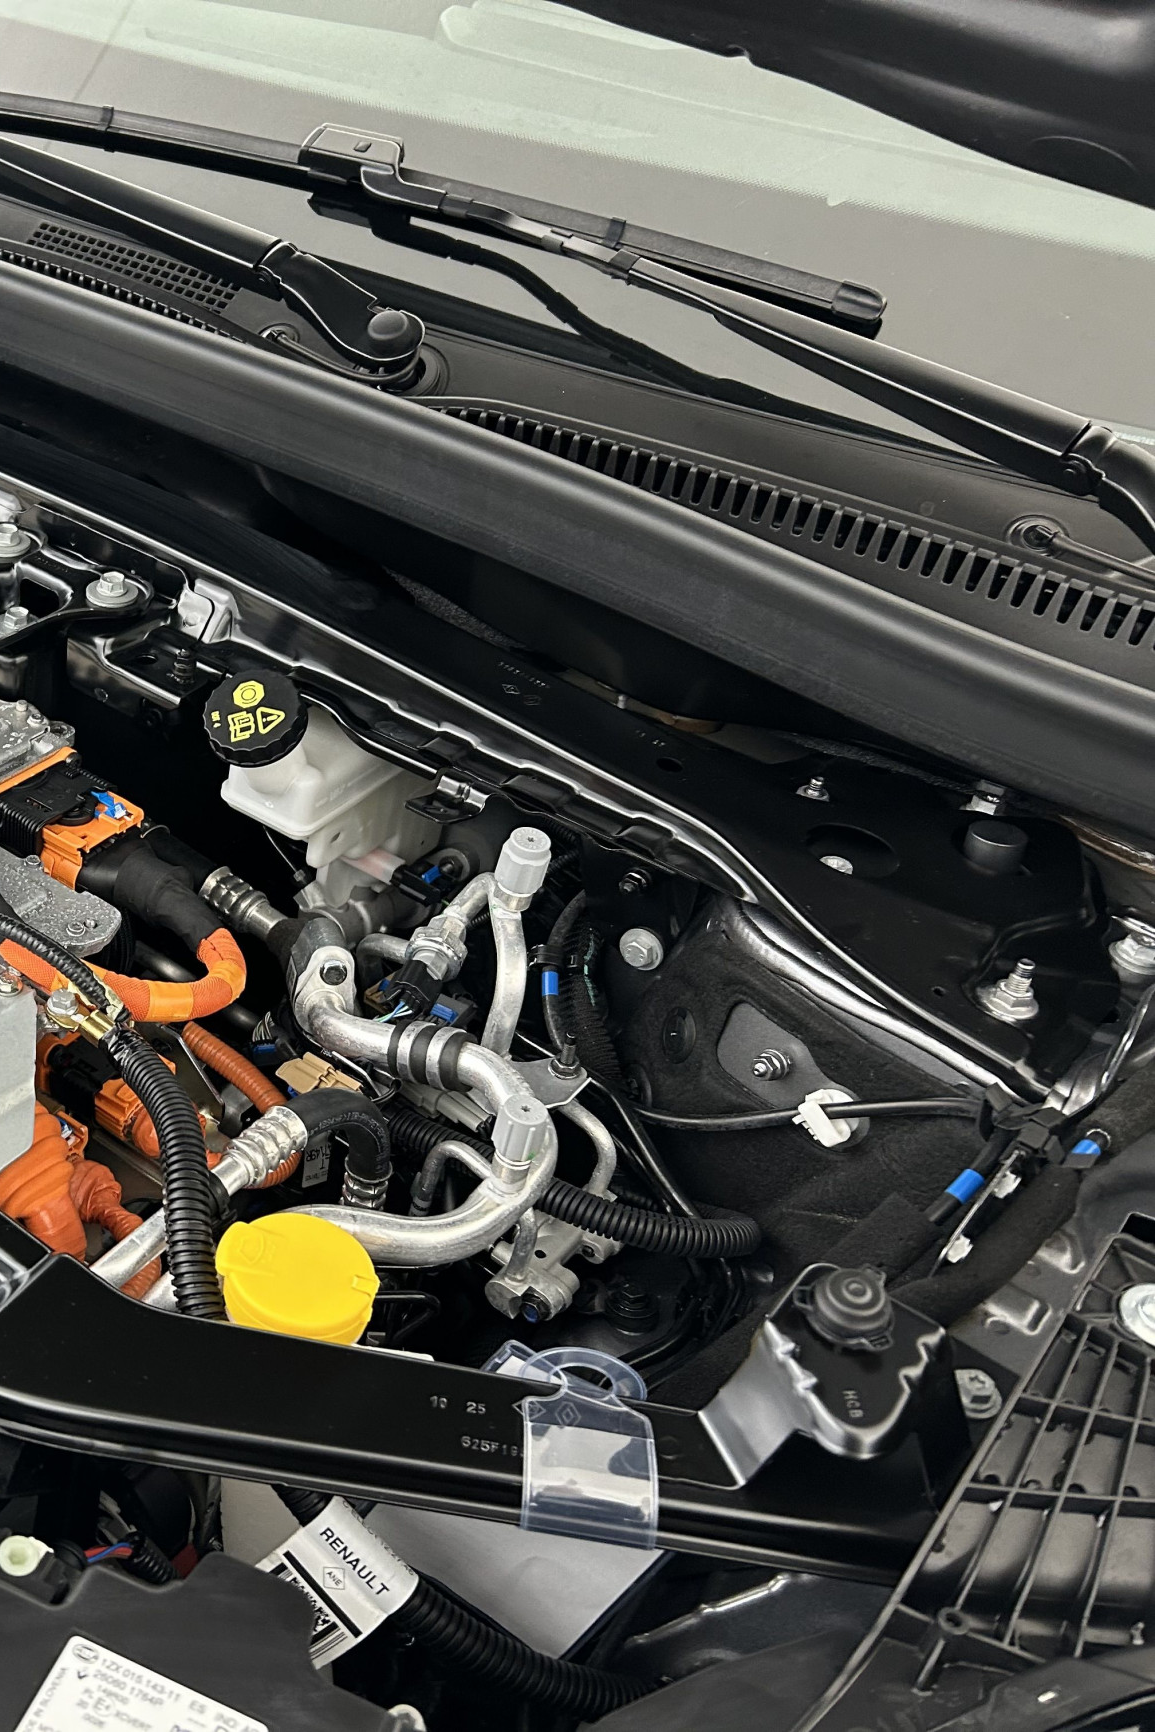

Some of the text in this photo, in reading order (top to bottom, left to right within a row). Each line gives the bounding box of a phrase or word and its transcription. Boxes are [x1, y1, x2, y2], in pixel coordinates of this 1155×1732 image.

[466, 1401, 486, 1414] 25
[319, 1527, 390, 1597] RENAULT
[326, 1570, 342, 1586] ANE
